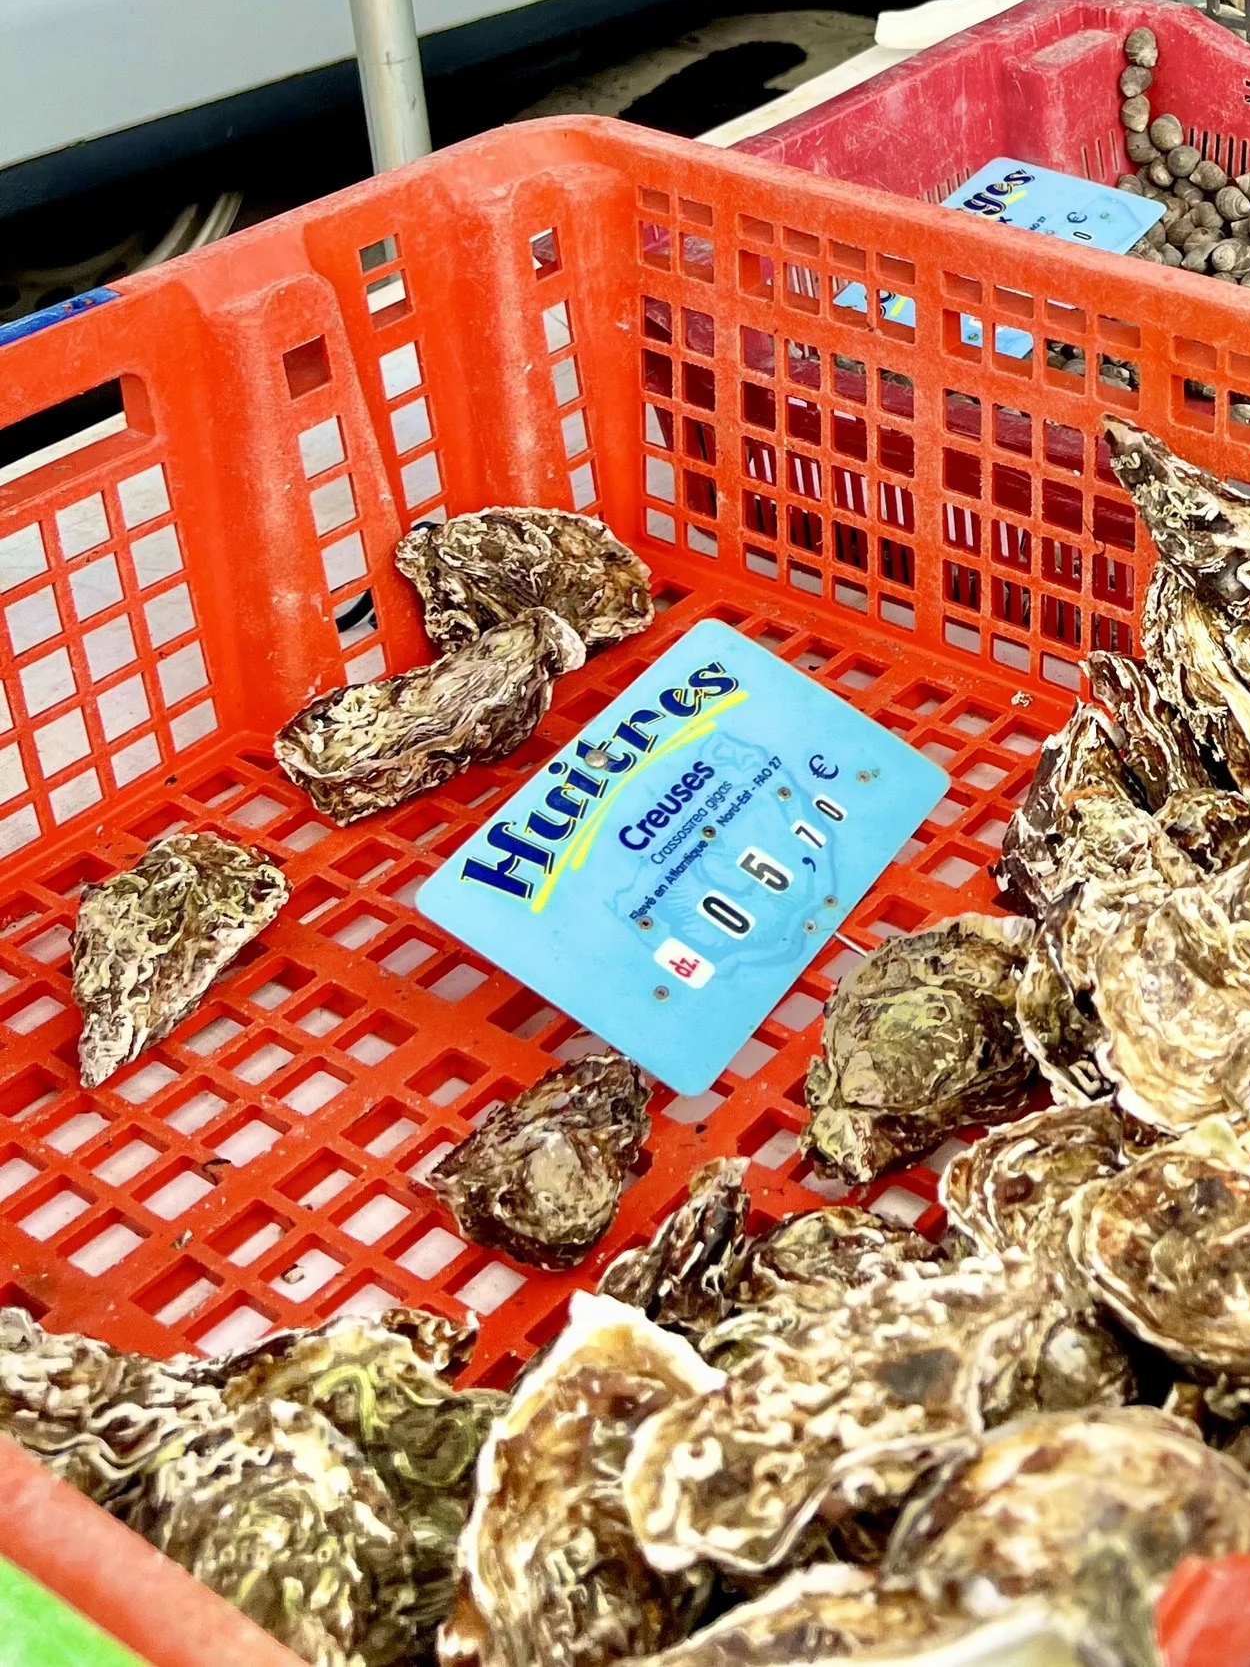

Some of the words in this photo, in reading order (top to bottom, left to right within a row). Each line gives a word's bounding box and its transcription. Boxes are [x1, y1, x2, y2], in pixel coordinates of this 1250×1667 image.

[618, 760, 716, 851] Creuses
[651, 807, 709, 865] Crassostrea
[705, 780, 733, 813] gigas
[654, 883, 666, 900] en
[665, 839, 709, 885] Atlantique
[716, 789, 753, 828] Nord-Est
[753, 767, 773, 787] FAO
[768, 755, 782, 771] 27
[669, 958, 700, 979] dz.
[808, 754, 839, 780] €
